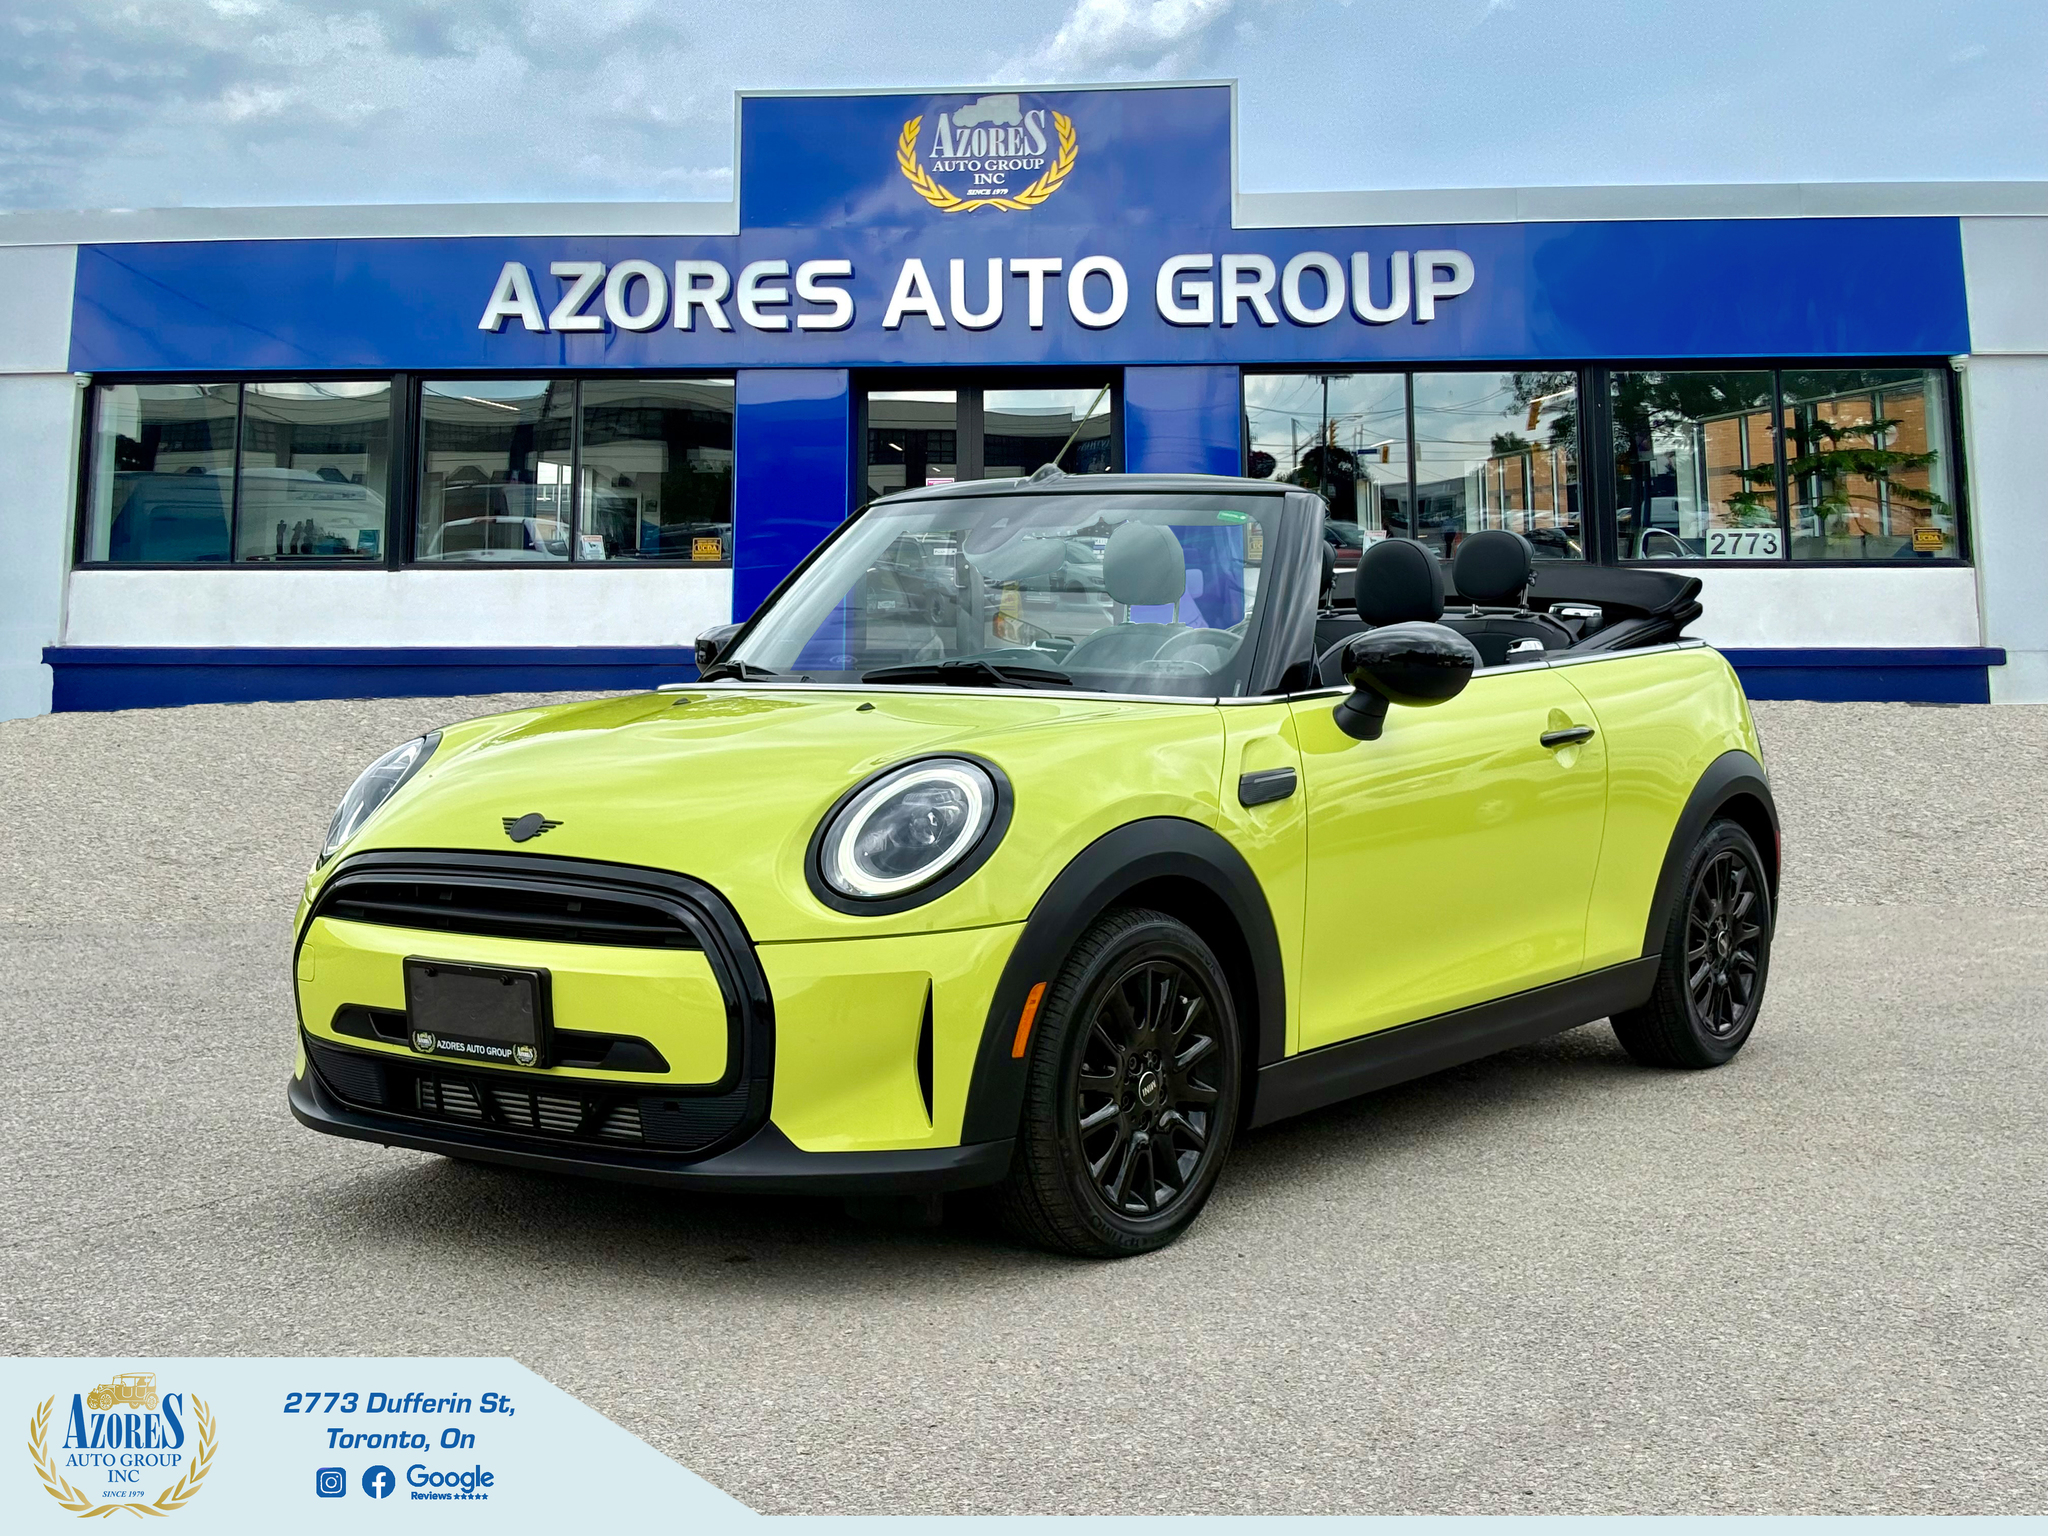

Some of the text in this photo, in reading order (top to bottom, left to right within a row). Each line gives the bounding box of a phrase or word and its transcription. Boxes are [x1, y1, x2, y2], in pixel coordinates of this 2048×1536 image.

[929, 110, 1048, 158] AZORES
[932, 158, 1045, 172] AUTO GROUP
[973, 173, 1005, 185] INC
[966, 188, 990, 196] SINCE
[478, 251, 1475, 332] AZORES AUTO GROUP
[1710, 533, 1778, 555] 2773
[437, 1040, 465, 1052] AZORES
[466, 1044, 485, 1054] AUTO
[486, 1046, 512, 1058] GROUP
